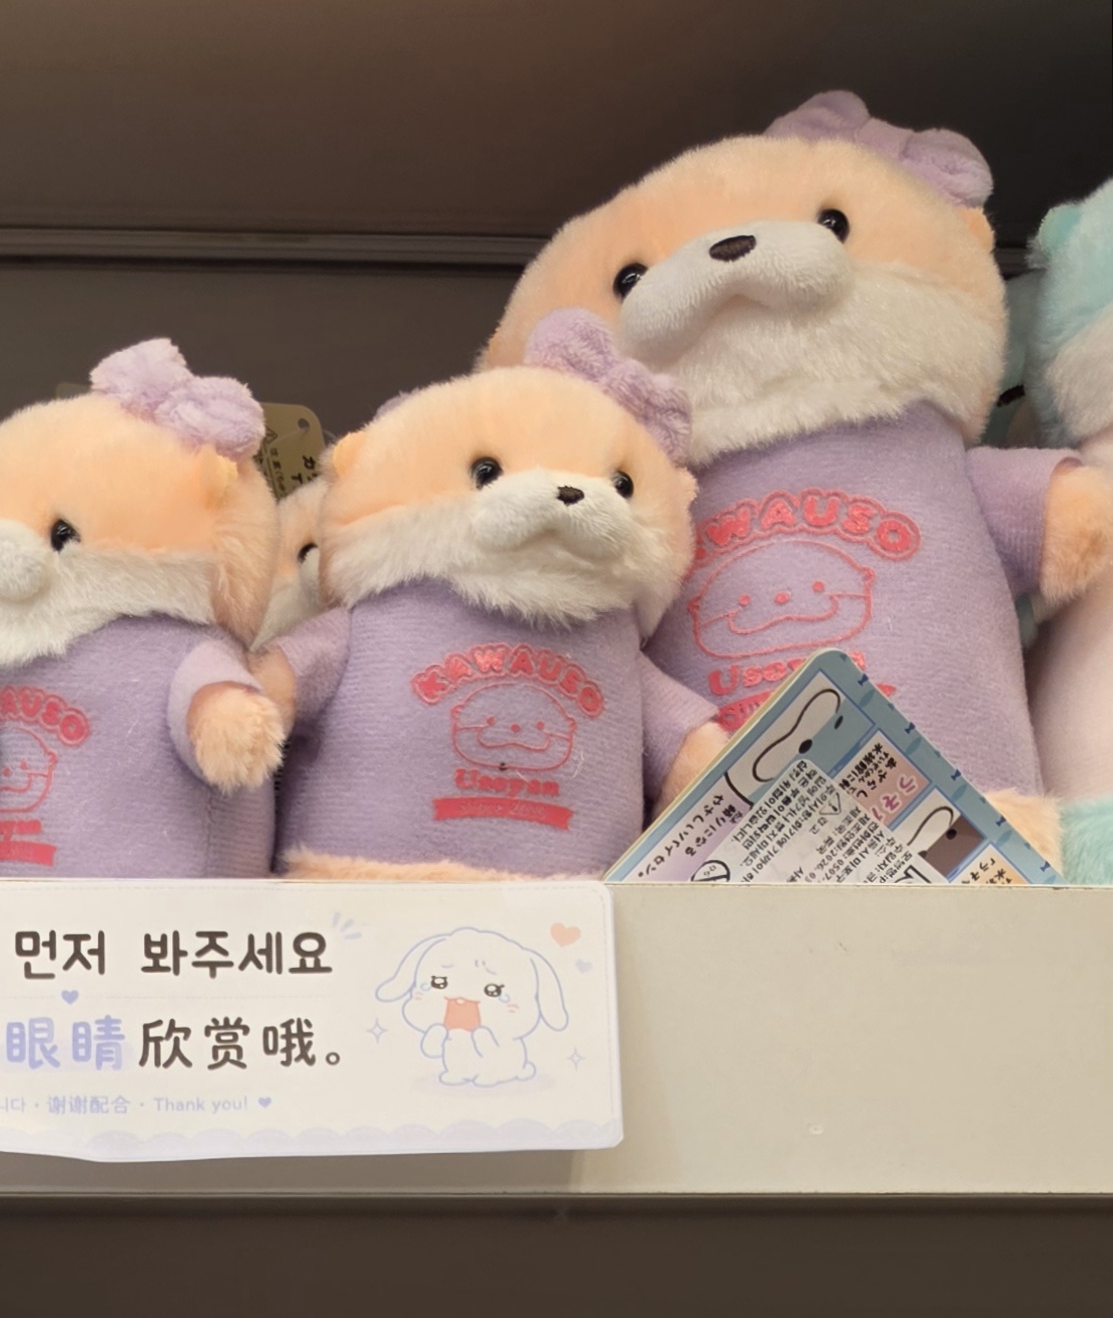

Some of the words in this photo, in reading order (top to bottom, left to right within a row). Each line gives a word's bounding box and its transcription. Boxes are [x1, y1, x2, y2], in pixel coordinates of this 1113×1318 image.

[695, 488, 921, 562] WAUSO
[411, 643, 604, 719] KAWAUSO
[15, 930, 106, 980] 먼저
[141, 930, 333, 979] 봐주세요
[154, 1097, 205, 1112] Thank
[211, 1096, 248, 1116] you!
